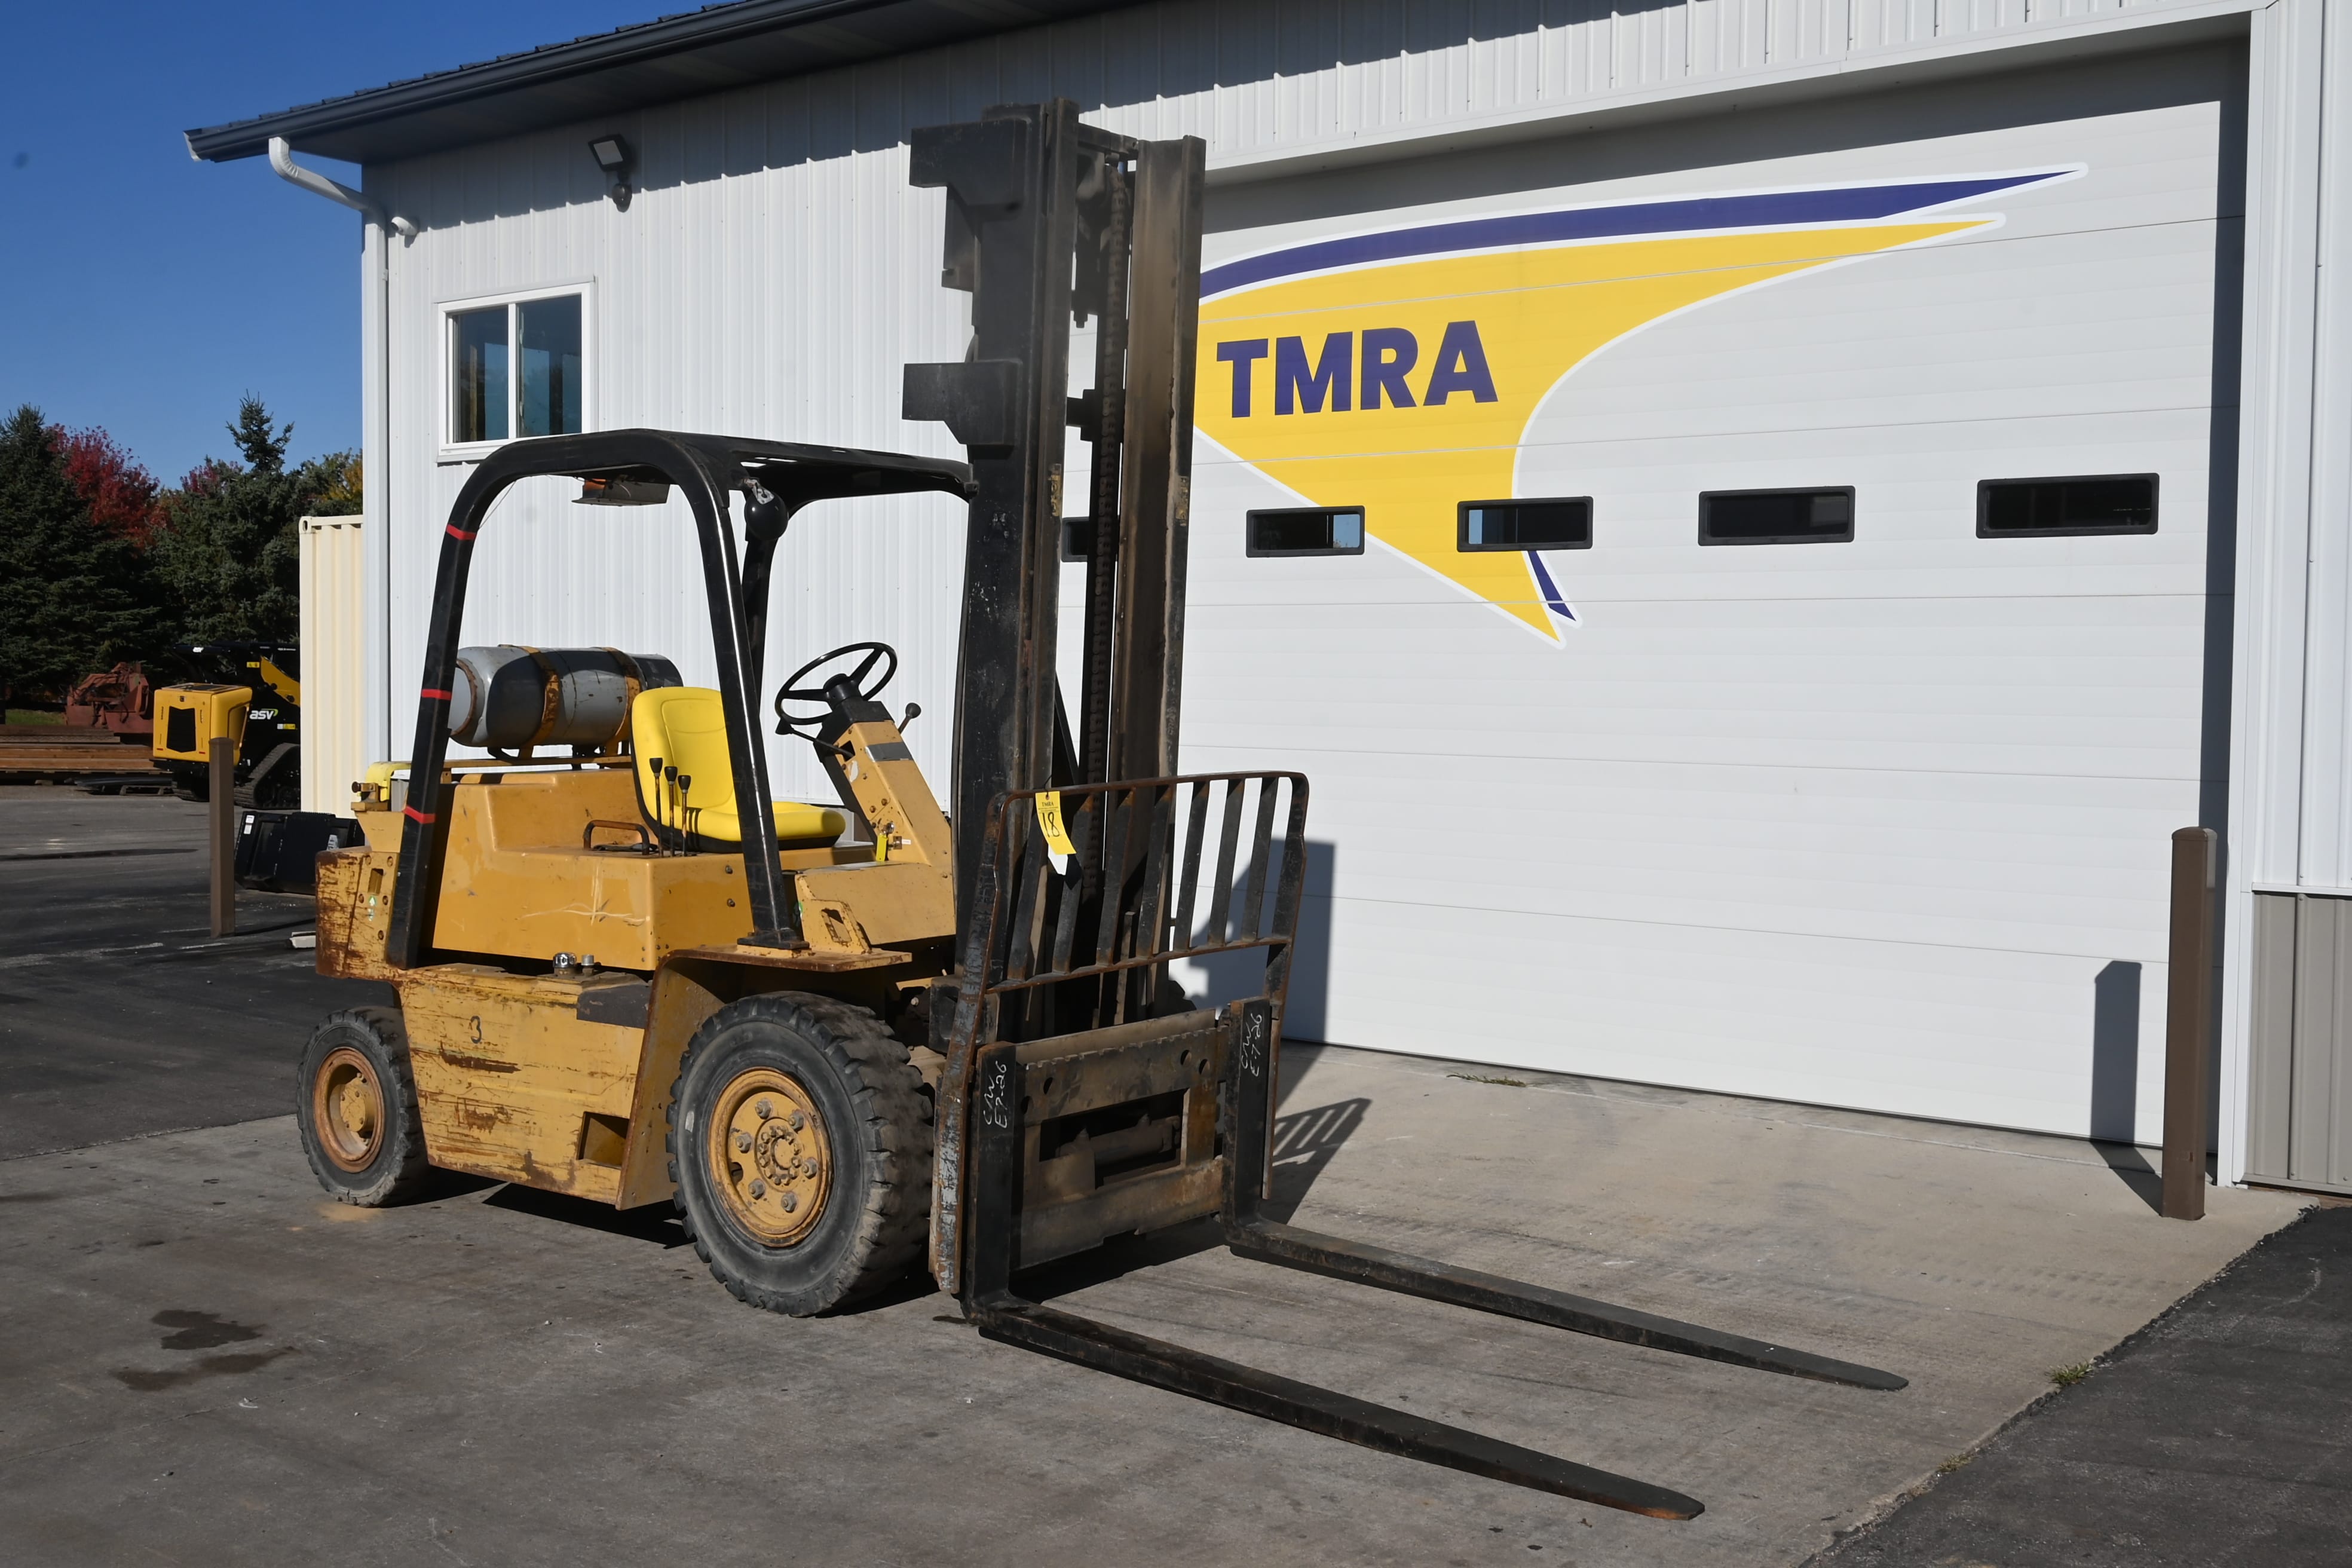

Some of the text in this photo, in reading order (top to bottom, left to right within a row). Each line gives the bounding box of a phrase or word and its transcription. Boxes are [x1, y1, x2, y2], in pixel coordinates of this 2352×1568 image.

[1217, 320, 1498, 418] TMRA
[250, 709, 275, 720] asv
[1042, 811, 1060, 838] 18
[470, 1015, 482, 1044] 3
